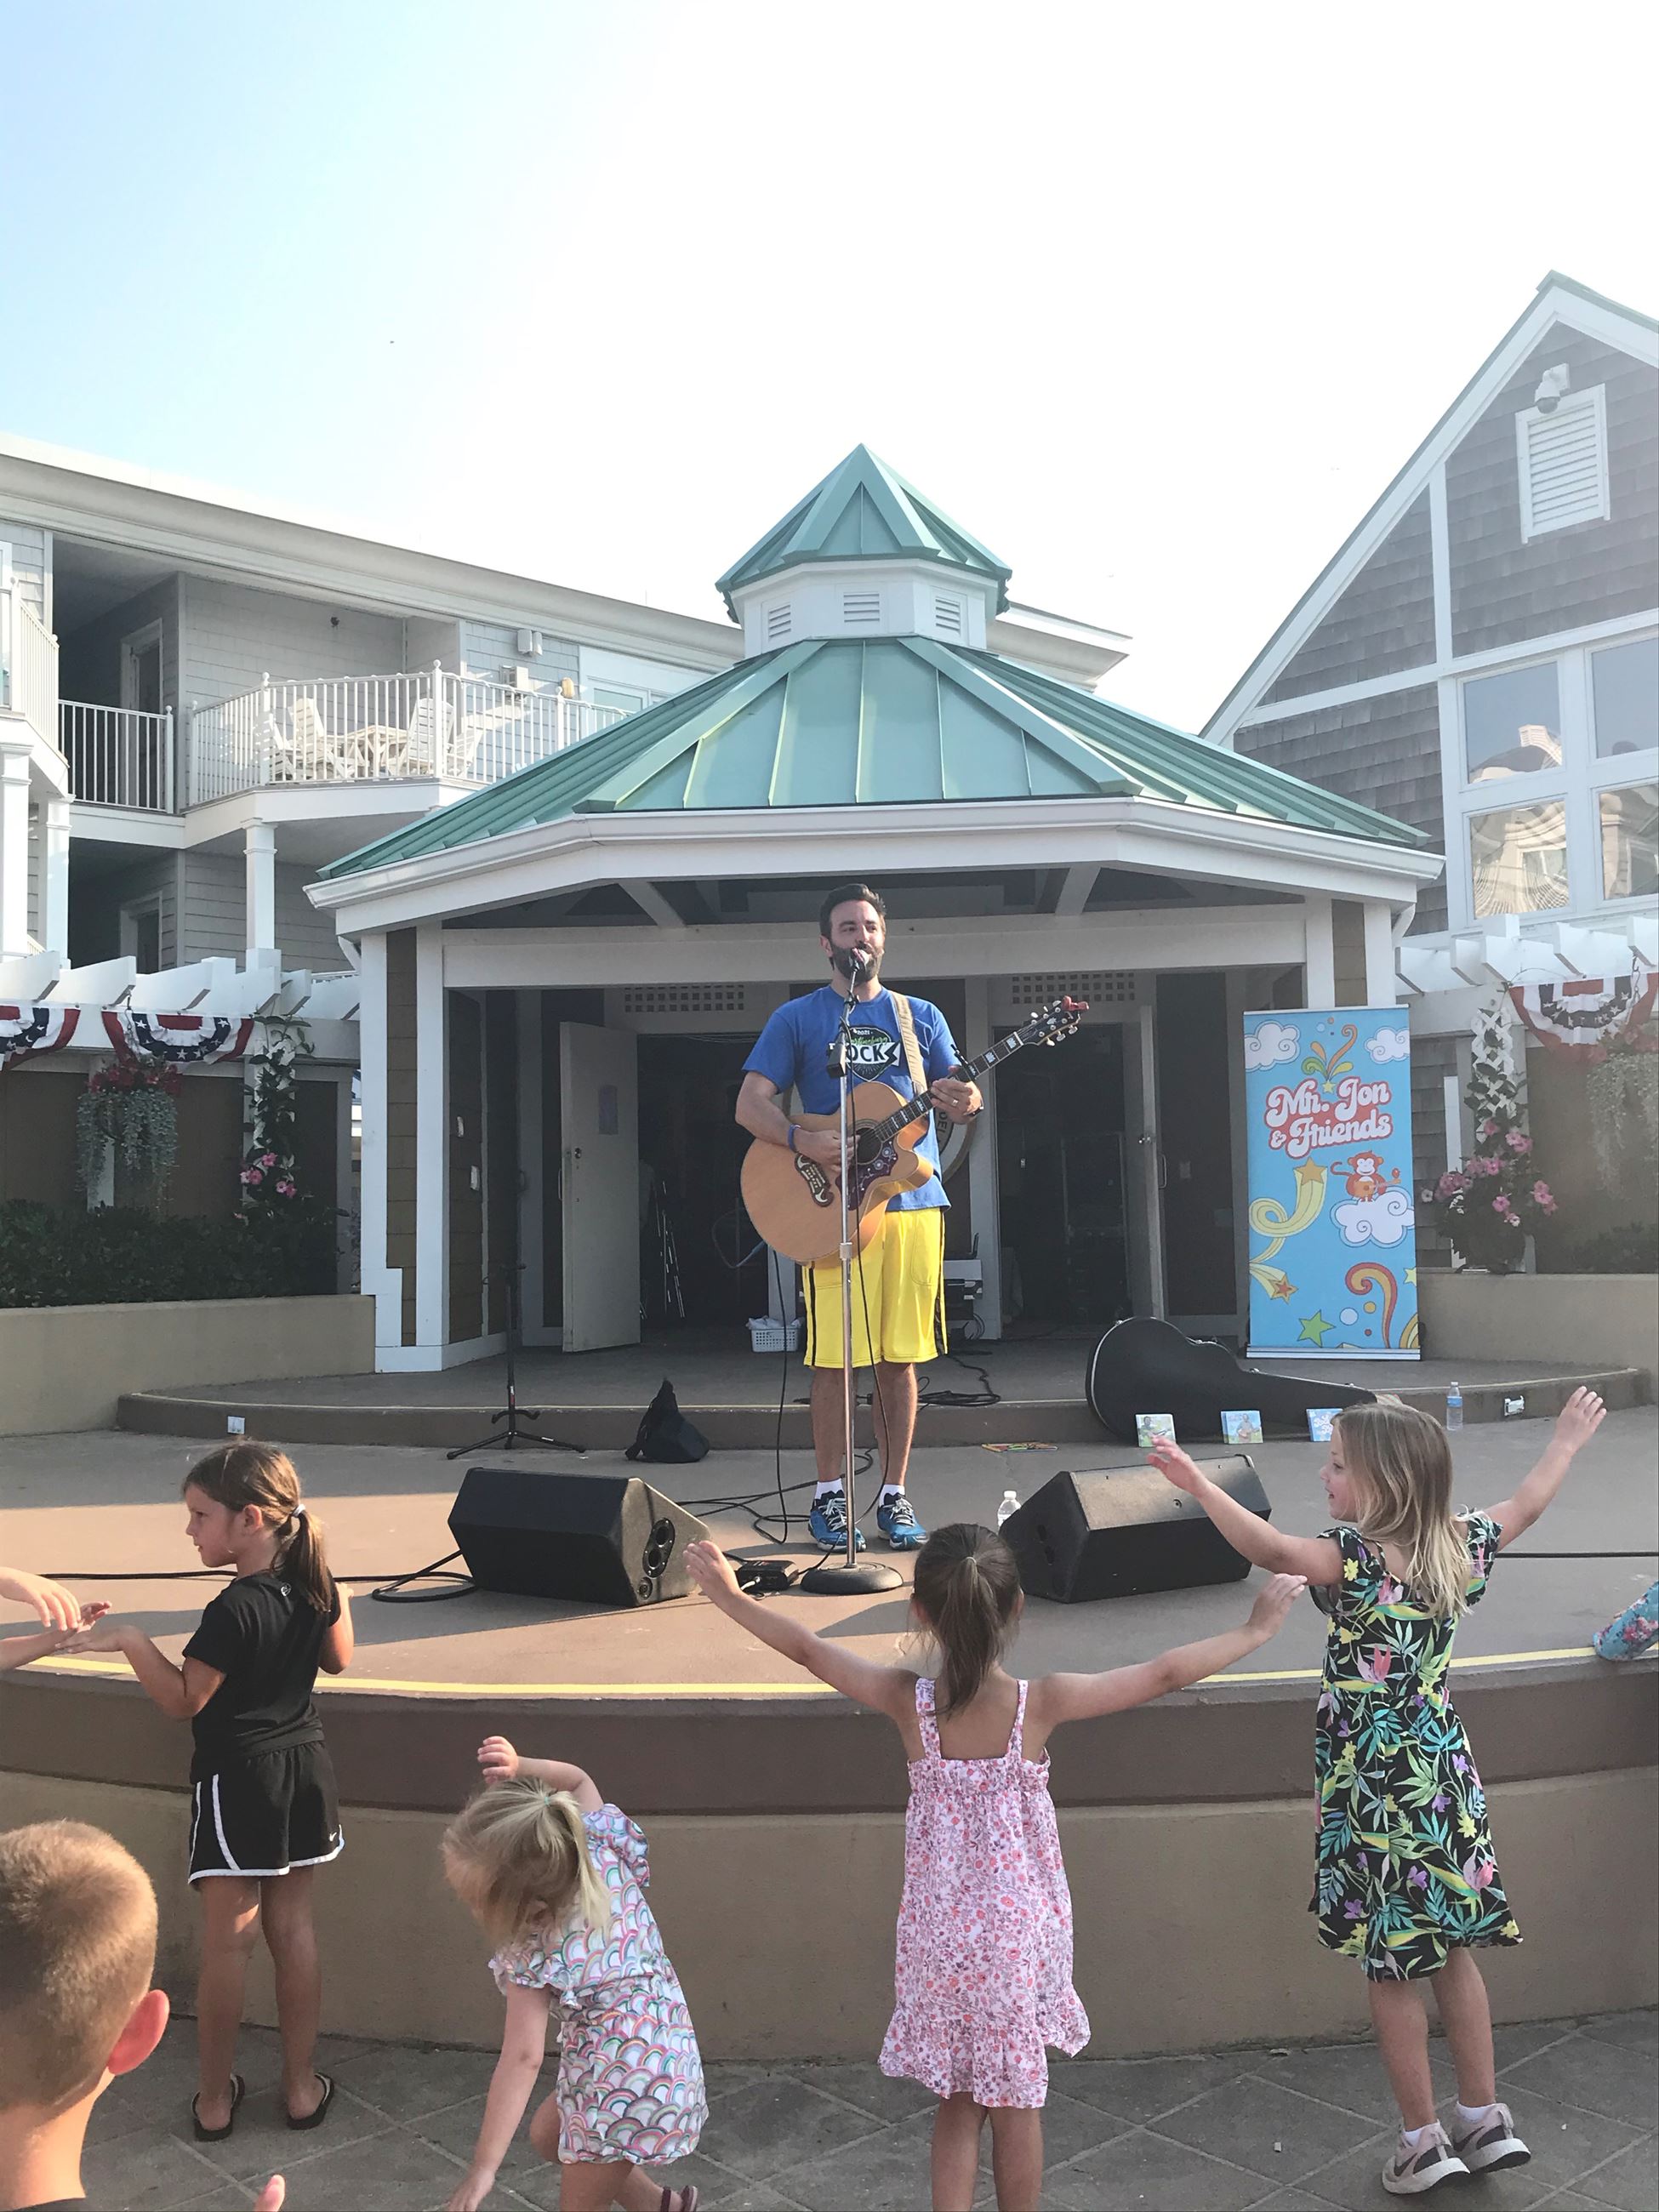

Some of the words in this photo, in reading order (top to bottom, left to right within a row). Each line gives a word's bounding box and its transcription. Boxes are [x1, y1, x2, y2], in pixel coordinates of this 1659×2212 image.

[1266, 1080, 1330, 1127] Mr.
[1335, 1078, 1389, 1121] Jon
[1270, 1131, 1286, 1148] &
[1287, 1109, 1391, 1157] Friends
